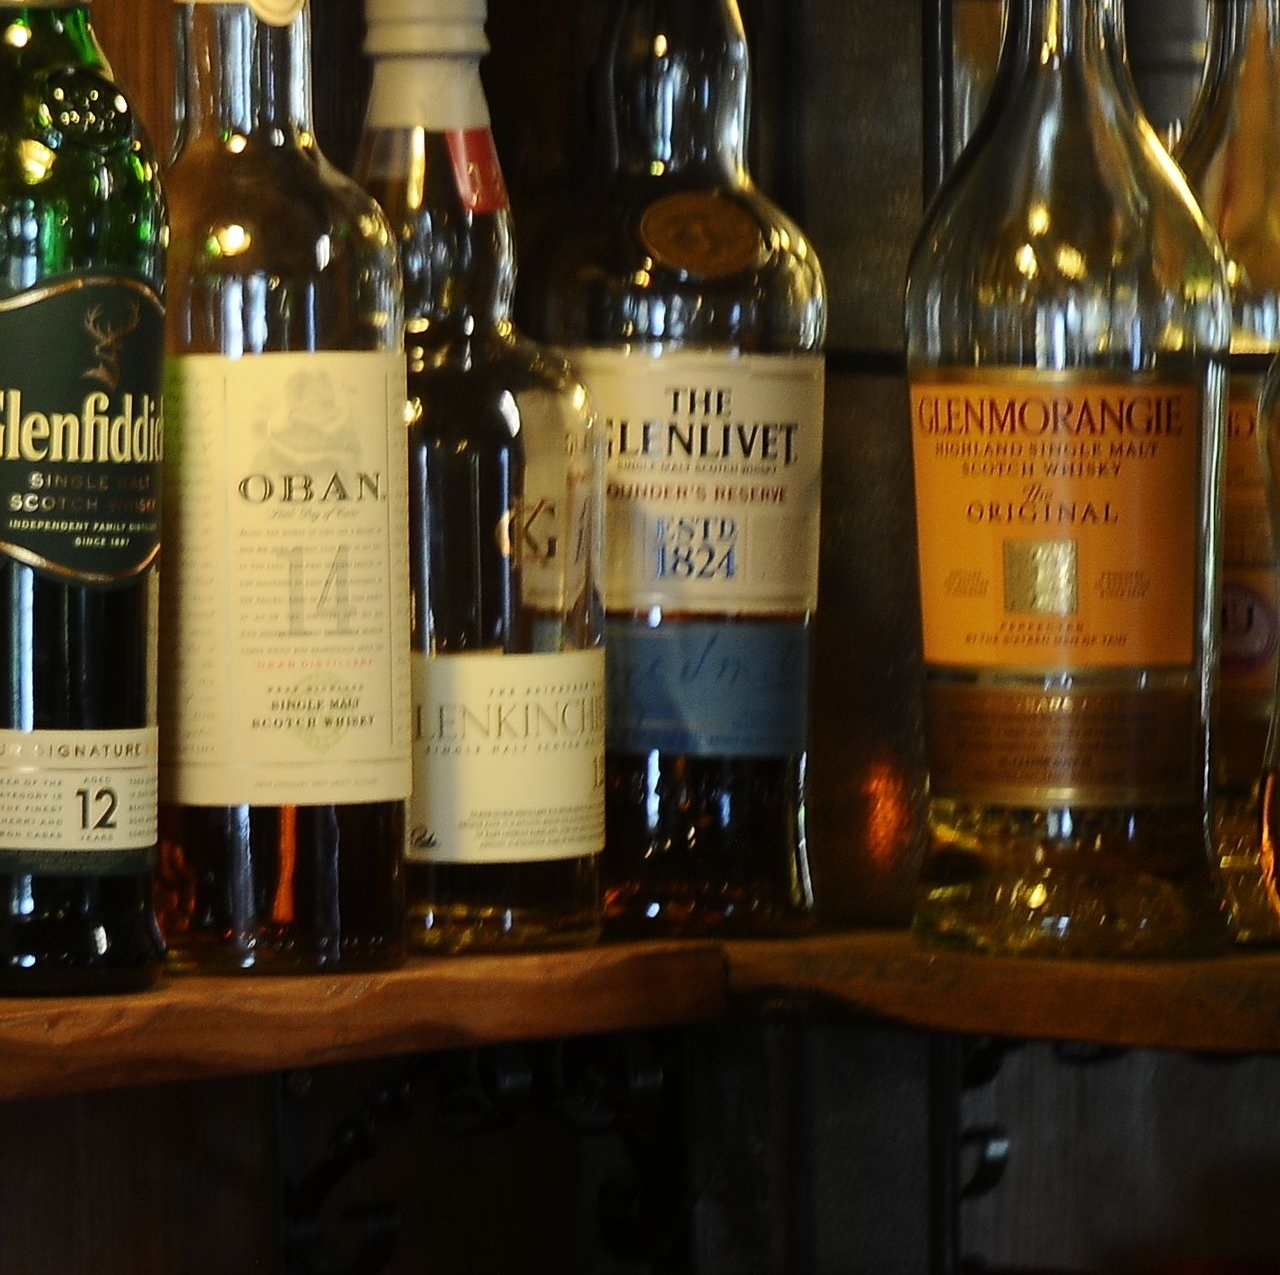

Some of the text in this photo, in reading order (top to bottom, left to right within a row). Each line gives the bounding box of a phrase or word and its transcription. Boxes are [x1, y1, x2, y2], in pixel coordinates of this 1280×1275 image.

[665, 388, 732, 416] THE
[919, 396, 1183, 436] GLENMORANGIE
[936, 442, 1157, 458] HIGHLAND SINGLE MALT
[962, 461, 1120, 477] SCOTCH WHISKY
[237, 471, 377, 503] OBAN
[967, 503, 1119, 525] ORIGINAL
[9, 519, 90, 532] INDEPENDENT
[74, 537, 106, 547] SINCE
[657, 545, 736, 579] 1824
[251, 717, 317, 729] SCOTCH
[76, 787, 118, 830] 12
